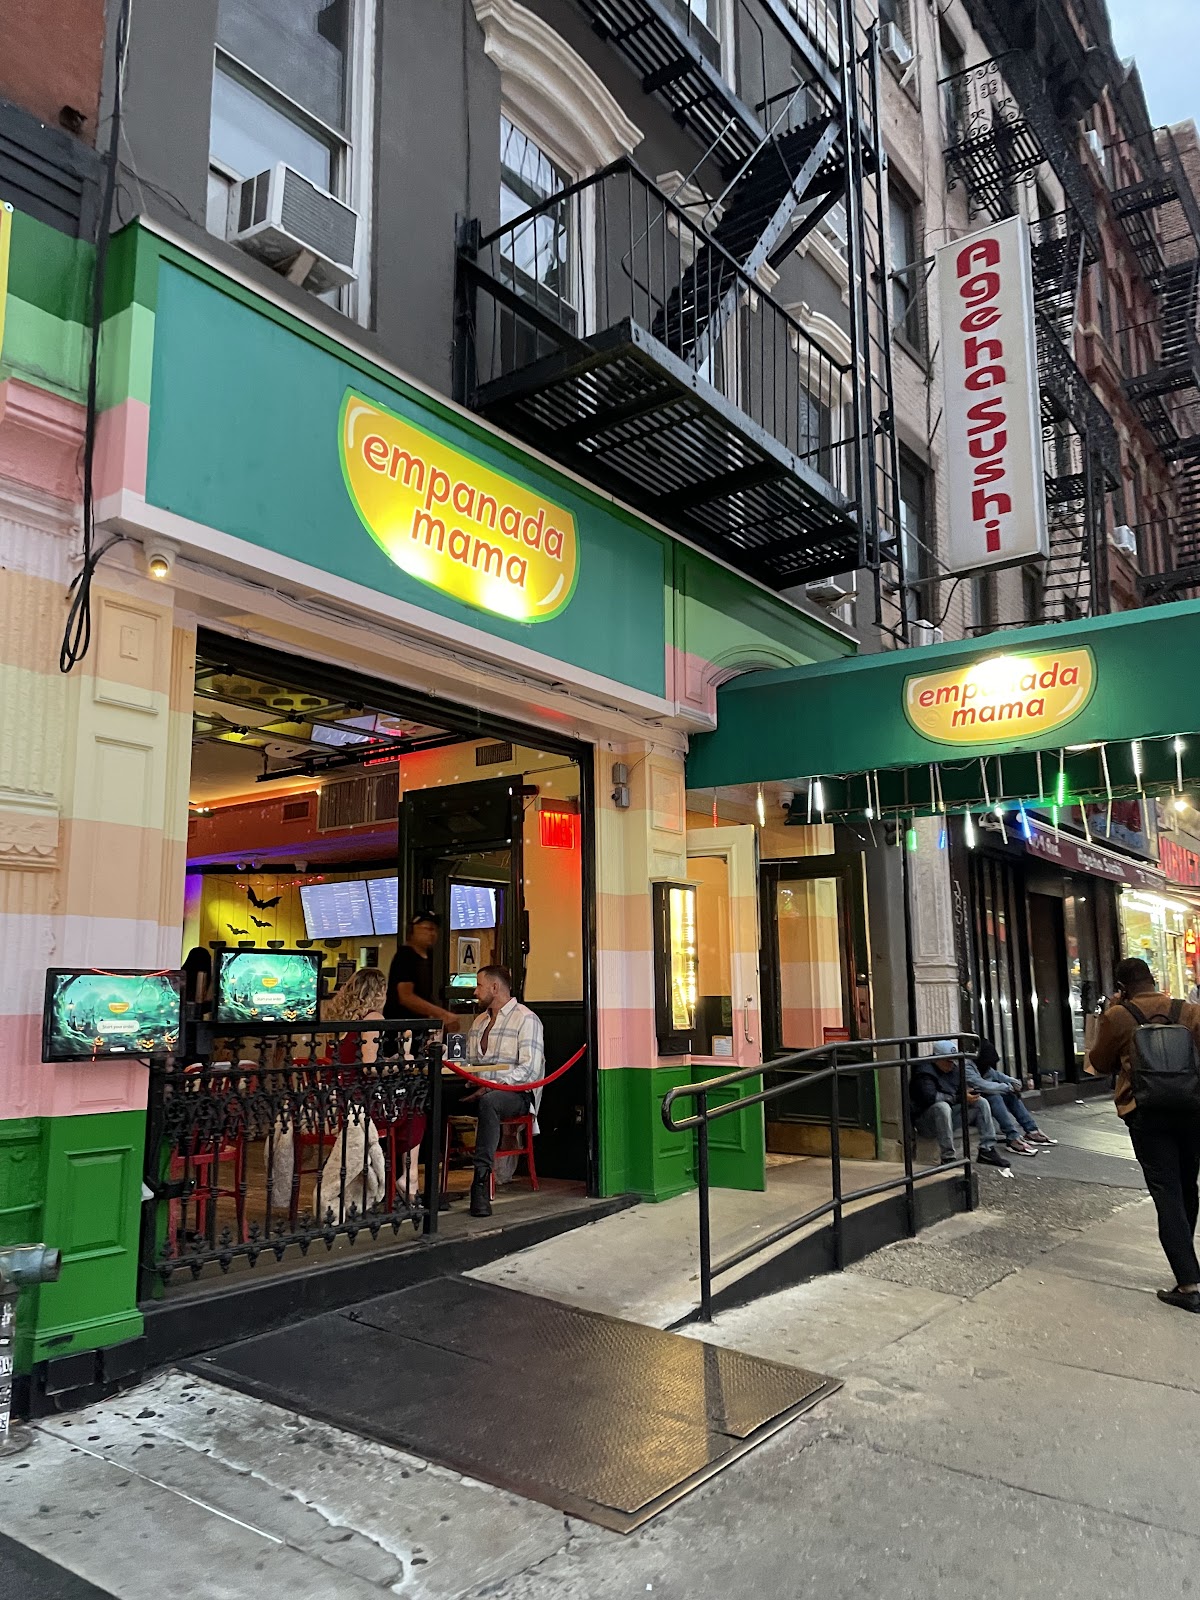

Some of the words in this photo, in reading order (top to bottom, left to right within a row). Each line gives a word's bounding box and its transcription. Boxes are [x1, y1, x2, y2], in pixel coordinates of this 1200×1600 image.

[362, 435, 565, 560] empanada
[966, 396, 1012, 553] Sushi
[410, 508, 528, 588] mama
[918, 662, 1079, 708] empada
[951, 697, 1045, 728] mama
[463, 944, 475, 964] A
